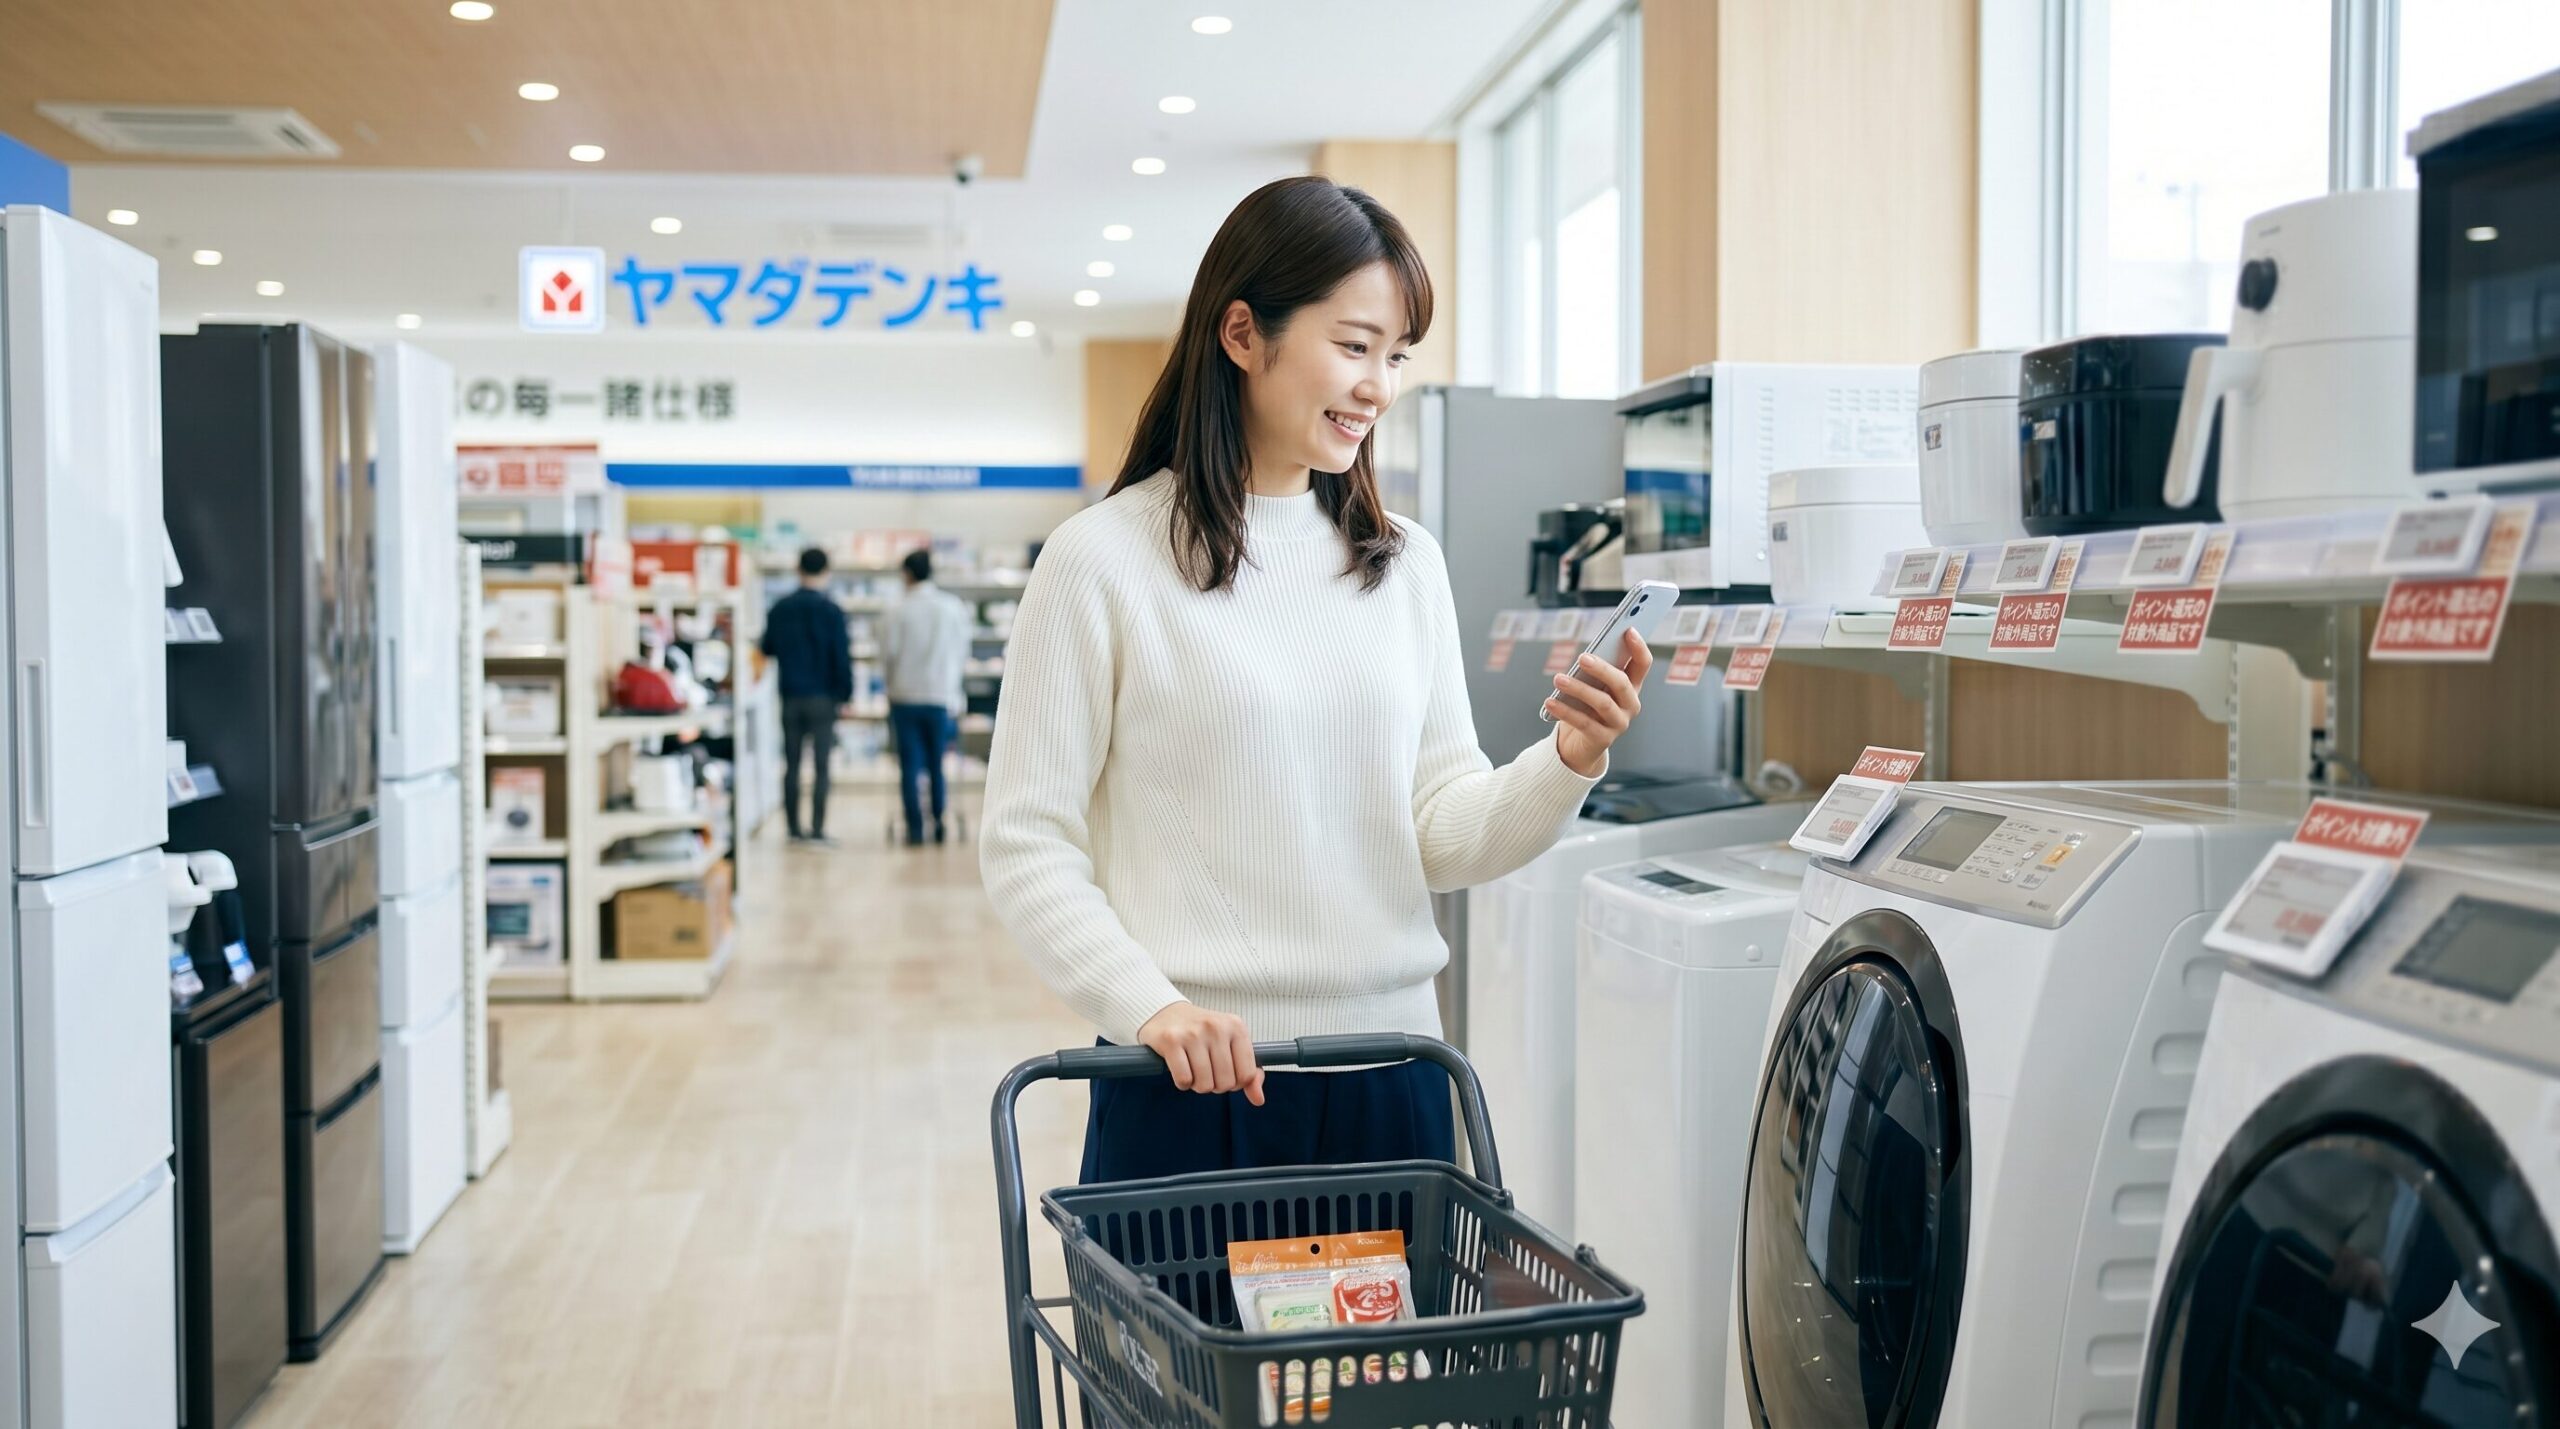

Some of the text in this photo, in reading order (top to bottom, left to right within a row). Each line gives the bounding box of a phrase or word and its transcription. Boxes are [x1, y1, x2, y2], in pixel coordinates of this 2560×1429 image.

[612, 258, 1002, 332] ヤマダデンキ
[2132, 597, 2207, 619] ポイント還元の
